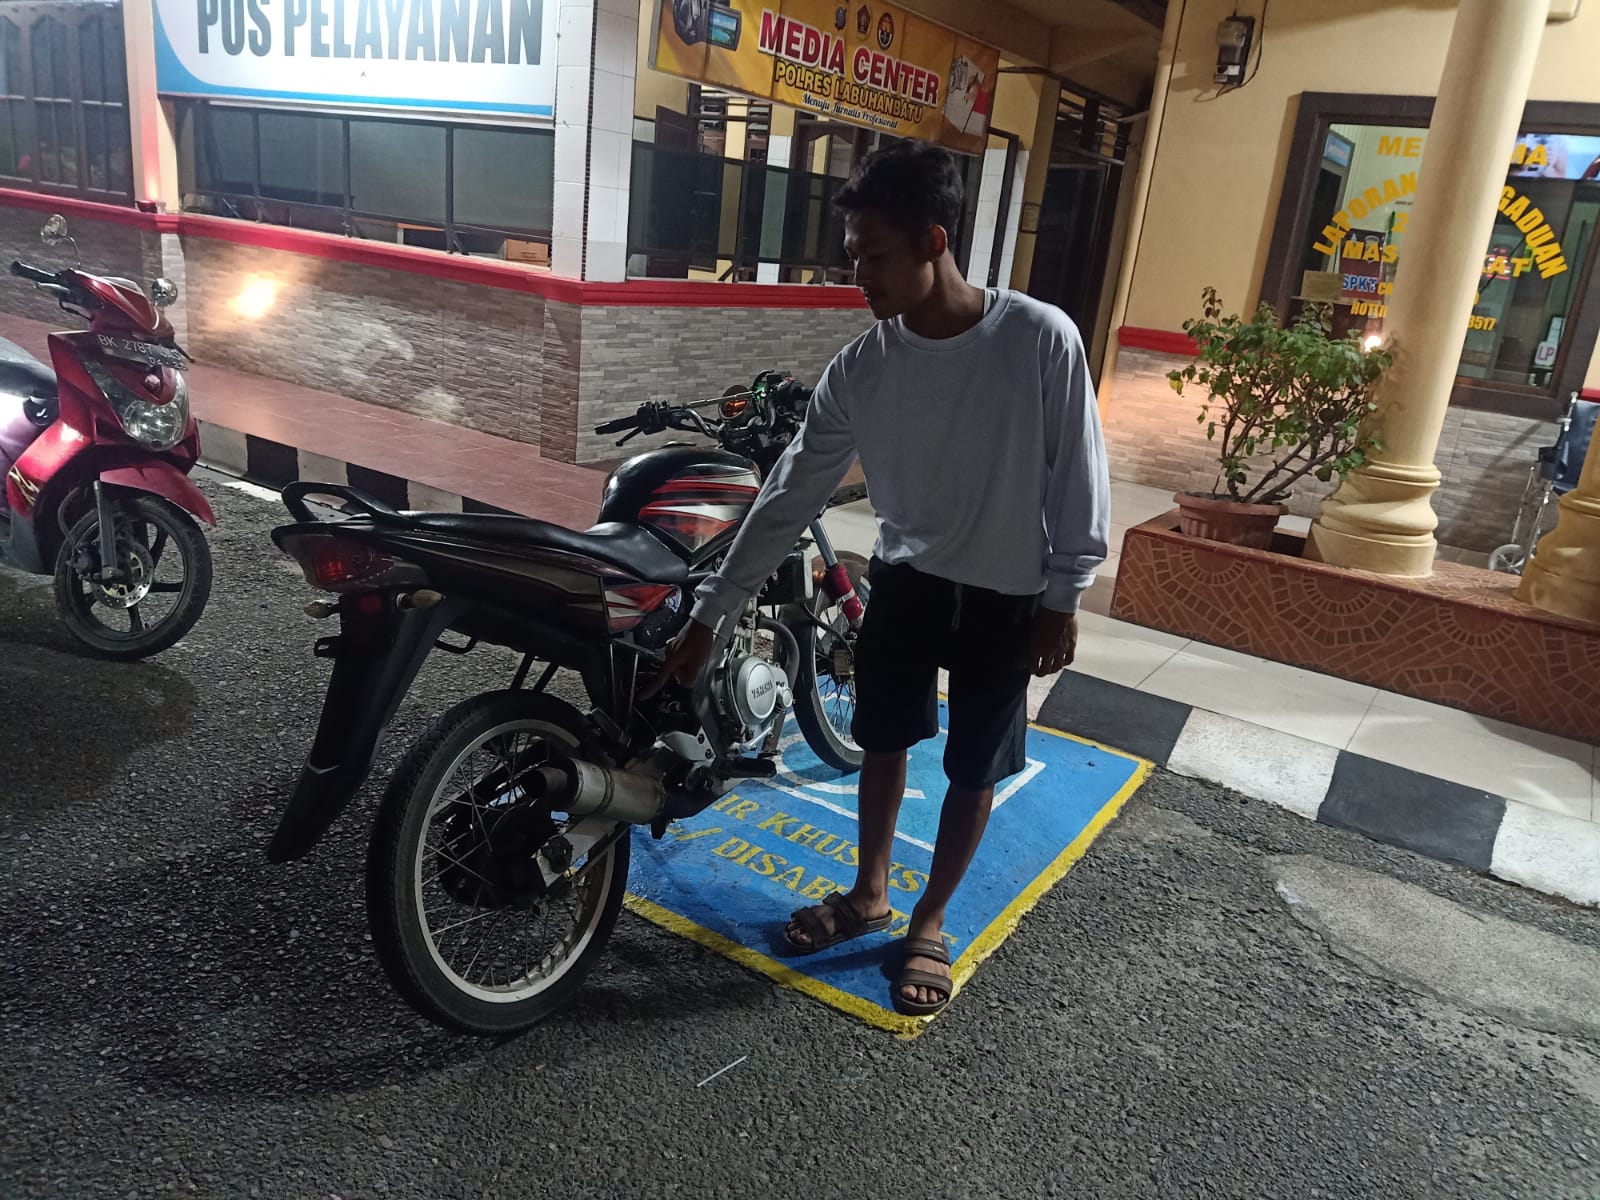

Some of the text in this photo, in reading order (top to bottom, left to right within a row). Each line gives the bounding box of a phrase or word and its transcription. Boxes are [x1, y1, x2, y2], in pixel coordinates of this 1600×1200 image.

[197, 0, 544, 66] POS PELAYANAN
[759, 9, 941, 108] MEDIA CENTER
[775, 60, 925, 124] POLRES LABUHANBATU
[801, 93, 831, 111] Menuju
[1377, 134, 1424, 158] ME
[1312, 171, 1568, 279] LAPORAN GADUAN
